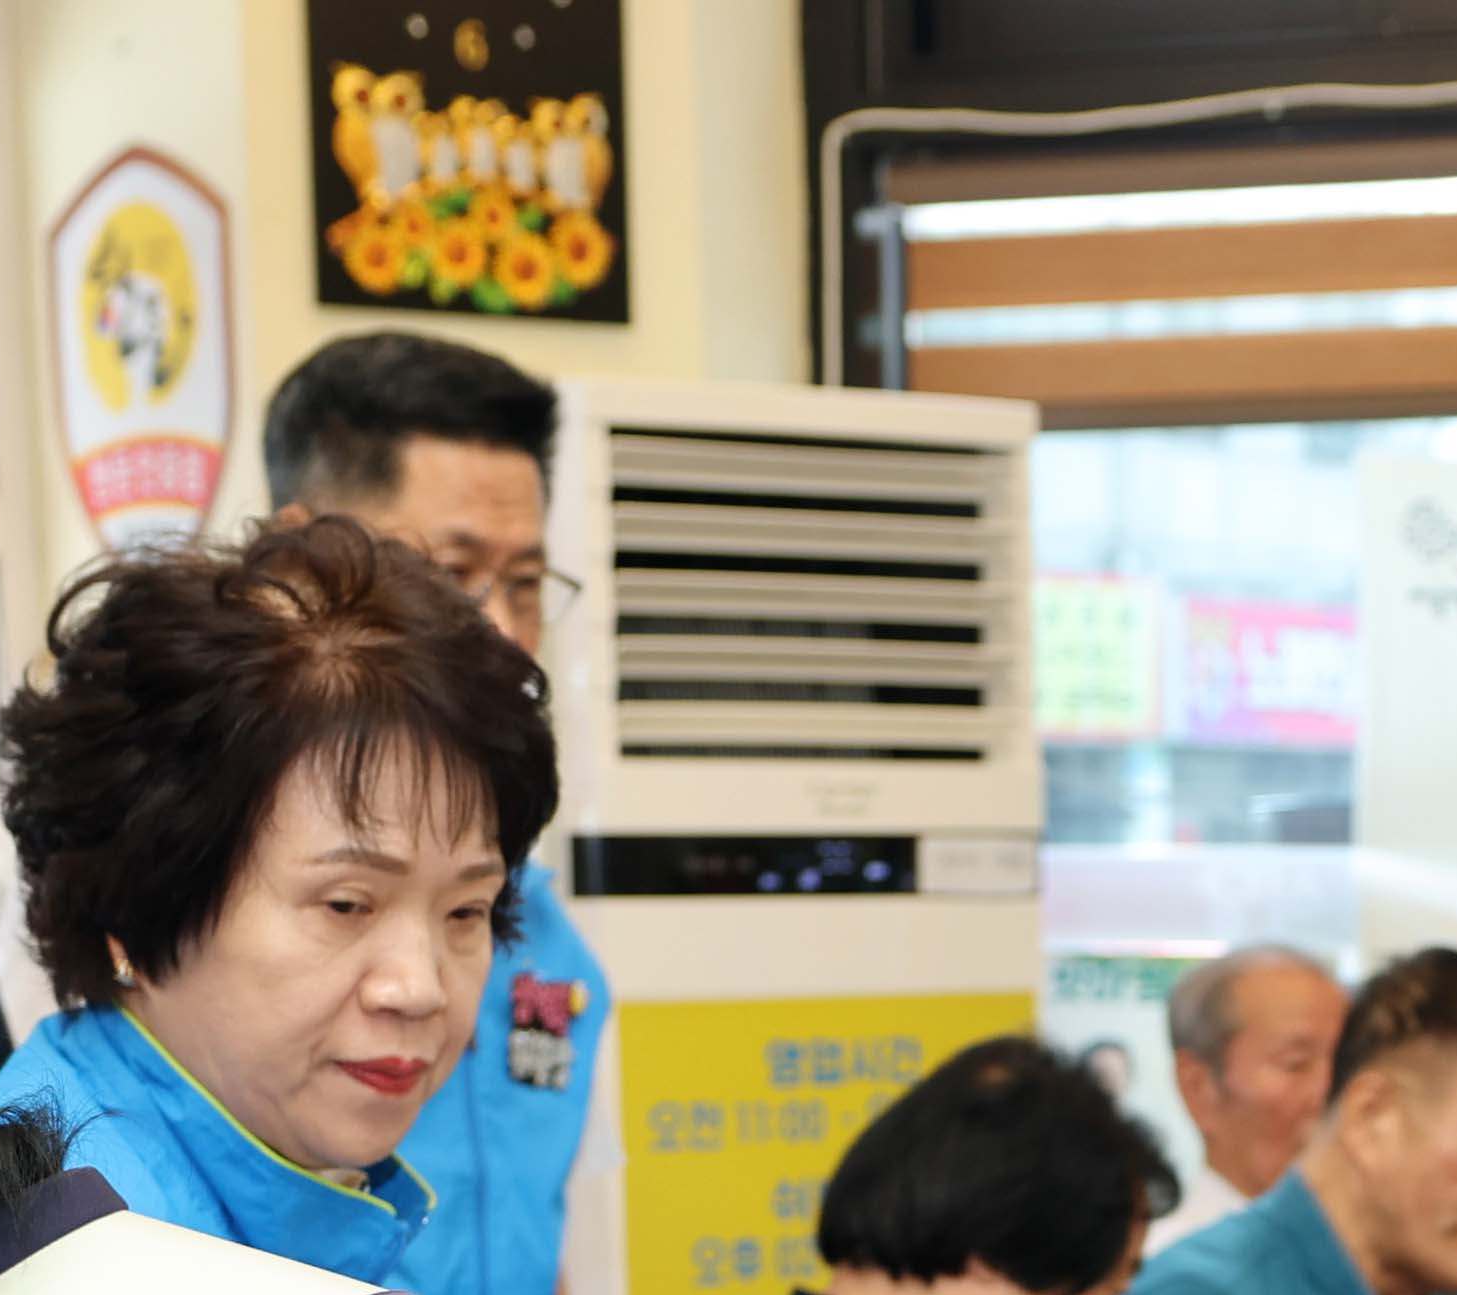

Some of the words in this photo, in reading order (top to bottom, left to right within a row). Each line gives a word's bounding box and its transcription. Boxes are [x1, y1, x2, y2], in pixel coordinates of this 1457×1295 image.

[763, 1036, 924, 1090] 영업시간
[646, 1100, 726, 1153] 오전
[689, 1237, 762, 1290] 오후
